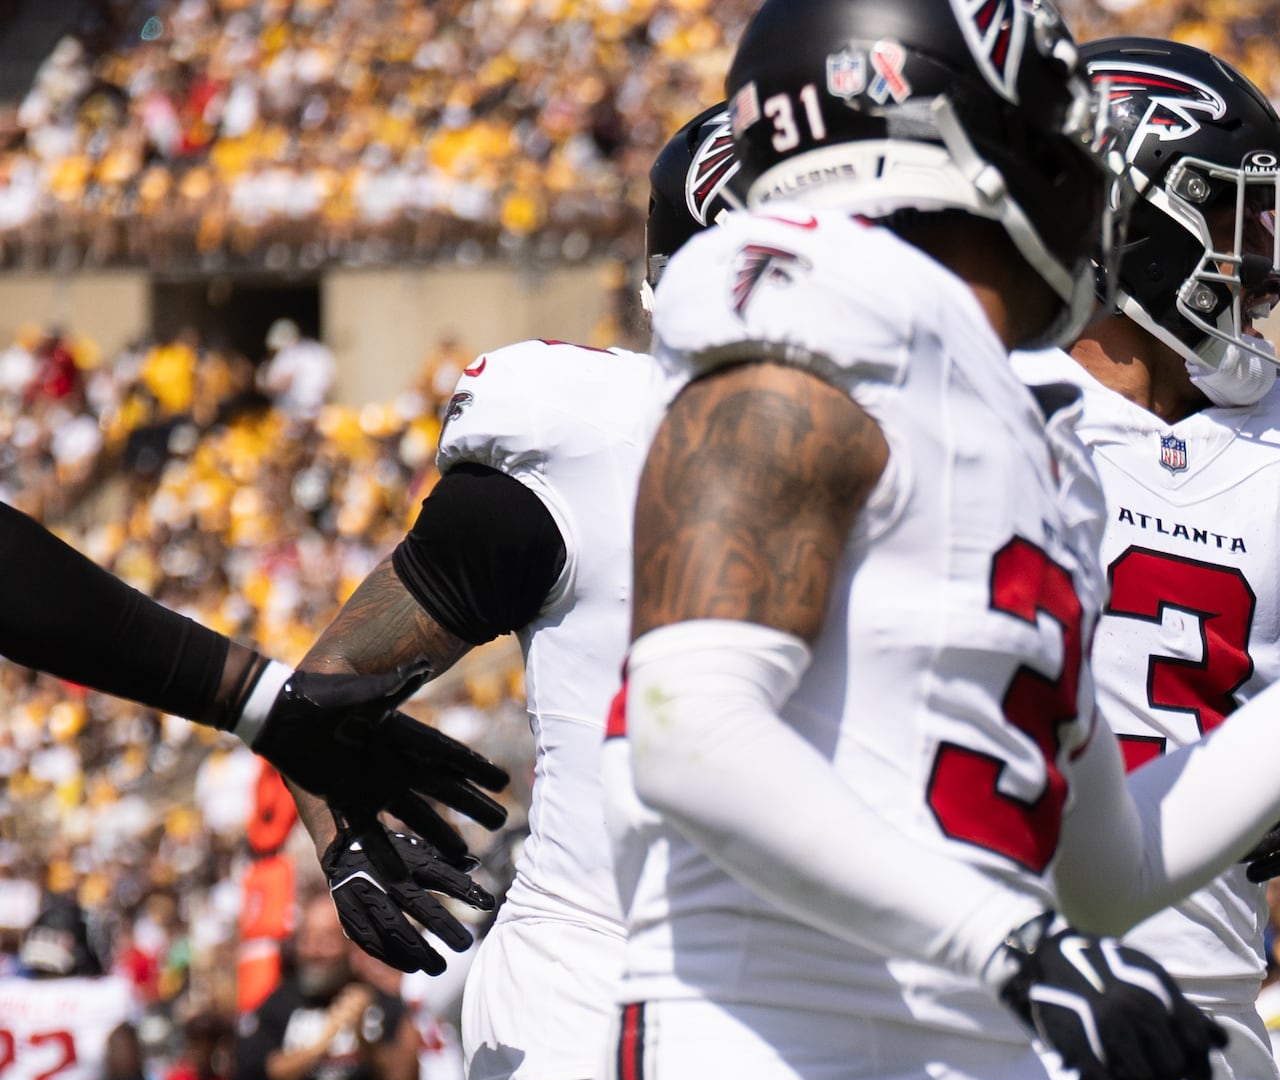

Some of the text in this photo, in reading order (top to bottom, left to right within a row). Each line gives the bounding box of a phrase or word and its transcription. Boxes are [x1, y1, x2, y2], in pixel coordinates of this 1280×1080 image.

[764, 83, 827, 152] 31
[1118, 506, 1247, 553] ATLANTA
[925, 534, 1083, 877] 3
